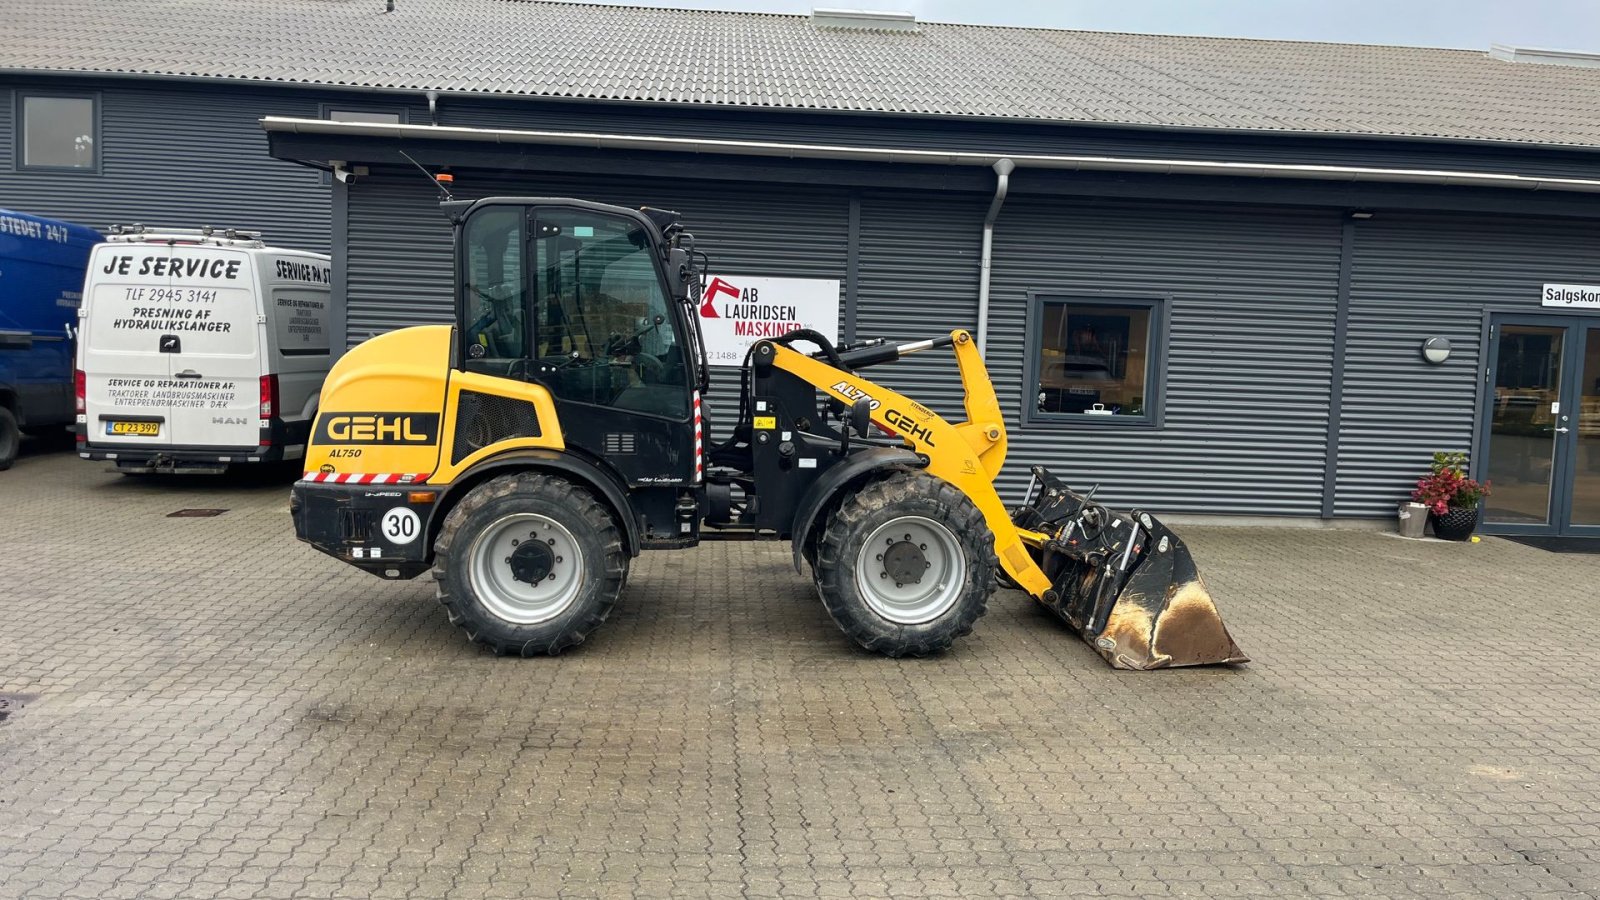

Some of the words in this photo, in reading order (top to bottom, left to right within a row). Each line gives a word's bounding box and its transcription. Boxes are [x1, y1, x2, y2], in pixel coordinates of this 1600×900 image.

[0, 215, 41, 239] STEDET
[45, 224, 68, 243] 24/7
[104, 256, 133, 275] JE
[139, 256, 241, 280] SERVICE
[276, 259, 310, 282] SERVICE
[125, 288, 145, 301] TLF
[149, 288, 182, 303] 2945
[187, 289, 217, 303] 3141
[742, 288, 758, 303] AB
[133, 307, 192, 319] PRESNING
[195, 310, 211, 320] AF
[725, 304, 796, 321] LAURIDSEN
[113, 319, 231, 333] HYDRAULIKSLANGER
[716, 352, 737, 360] 1488
[108, 379, 142, 388] SERVICE
[144, 380, 155, 388] OG
[157, 380, 220, 389] REPARATIONER
[222, 381, 236, 390] AF:
[108, 390, 149, 398] TRAKTORER
[152, 391, 235, 400] LANDBRUGSMASKINER
[115, 398, 205, 408] ENTREPRENØRMASKINER
[210, 400, 229, 409] DÆK
[212, 416, 248, 425] MAN
[113, 423, 125, 432] CT
[127, 423, 138, 432] 23
[140, 423, 157, 433] 399
[327, 416, 427, 441] GEHL
[885, 409, 935, 447] GEHL
[329, 449, 362, 458] AL750
[388, 515, 414, 537] 30
